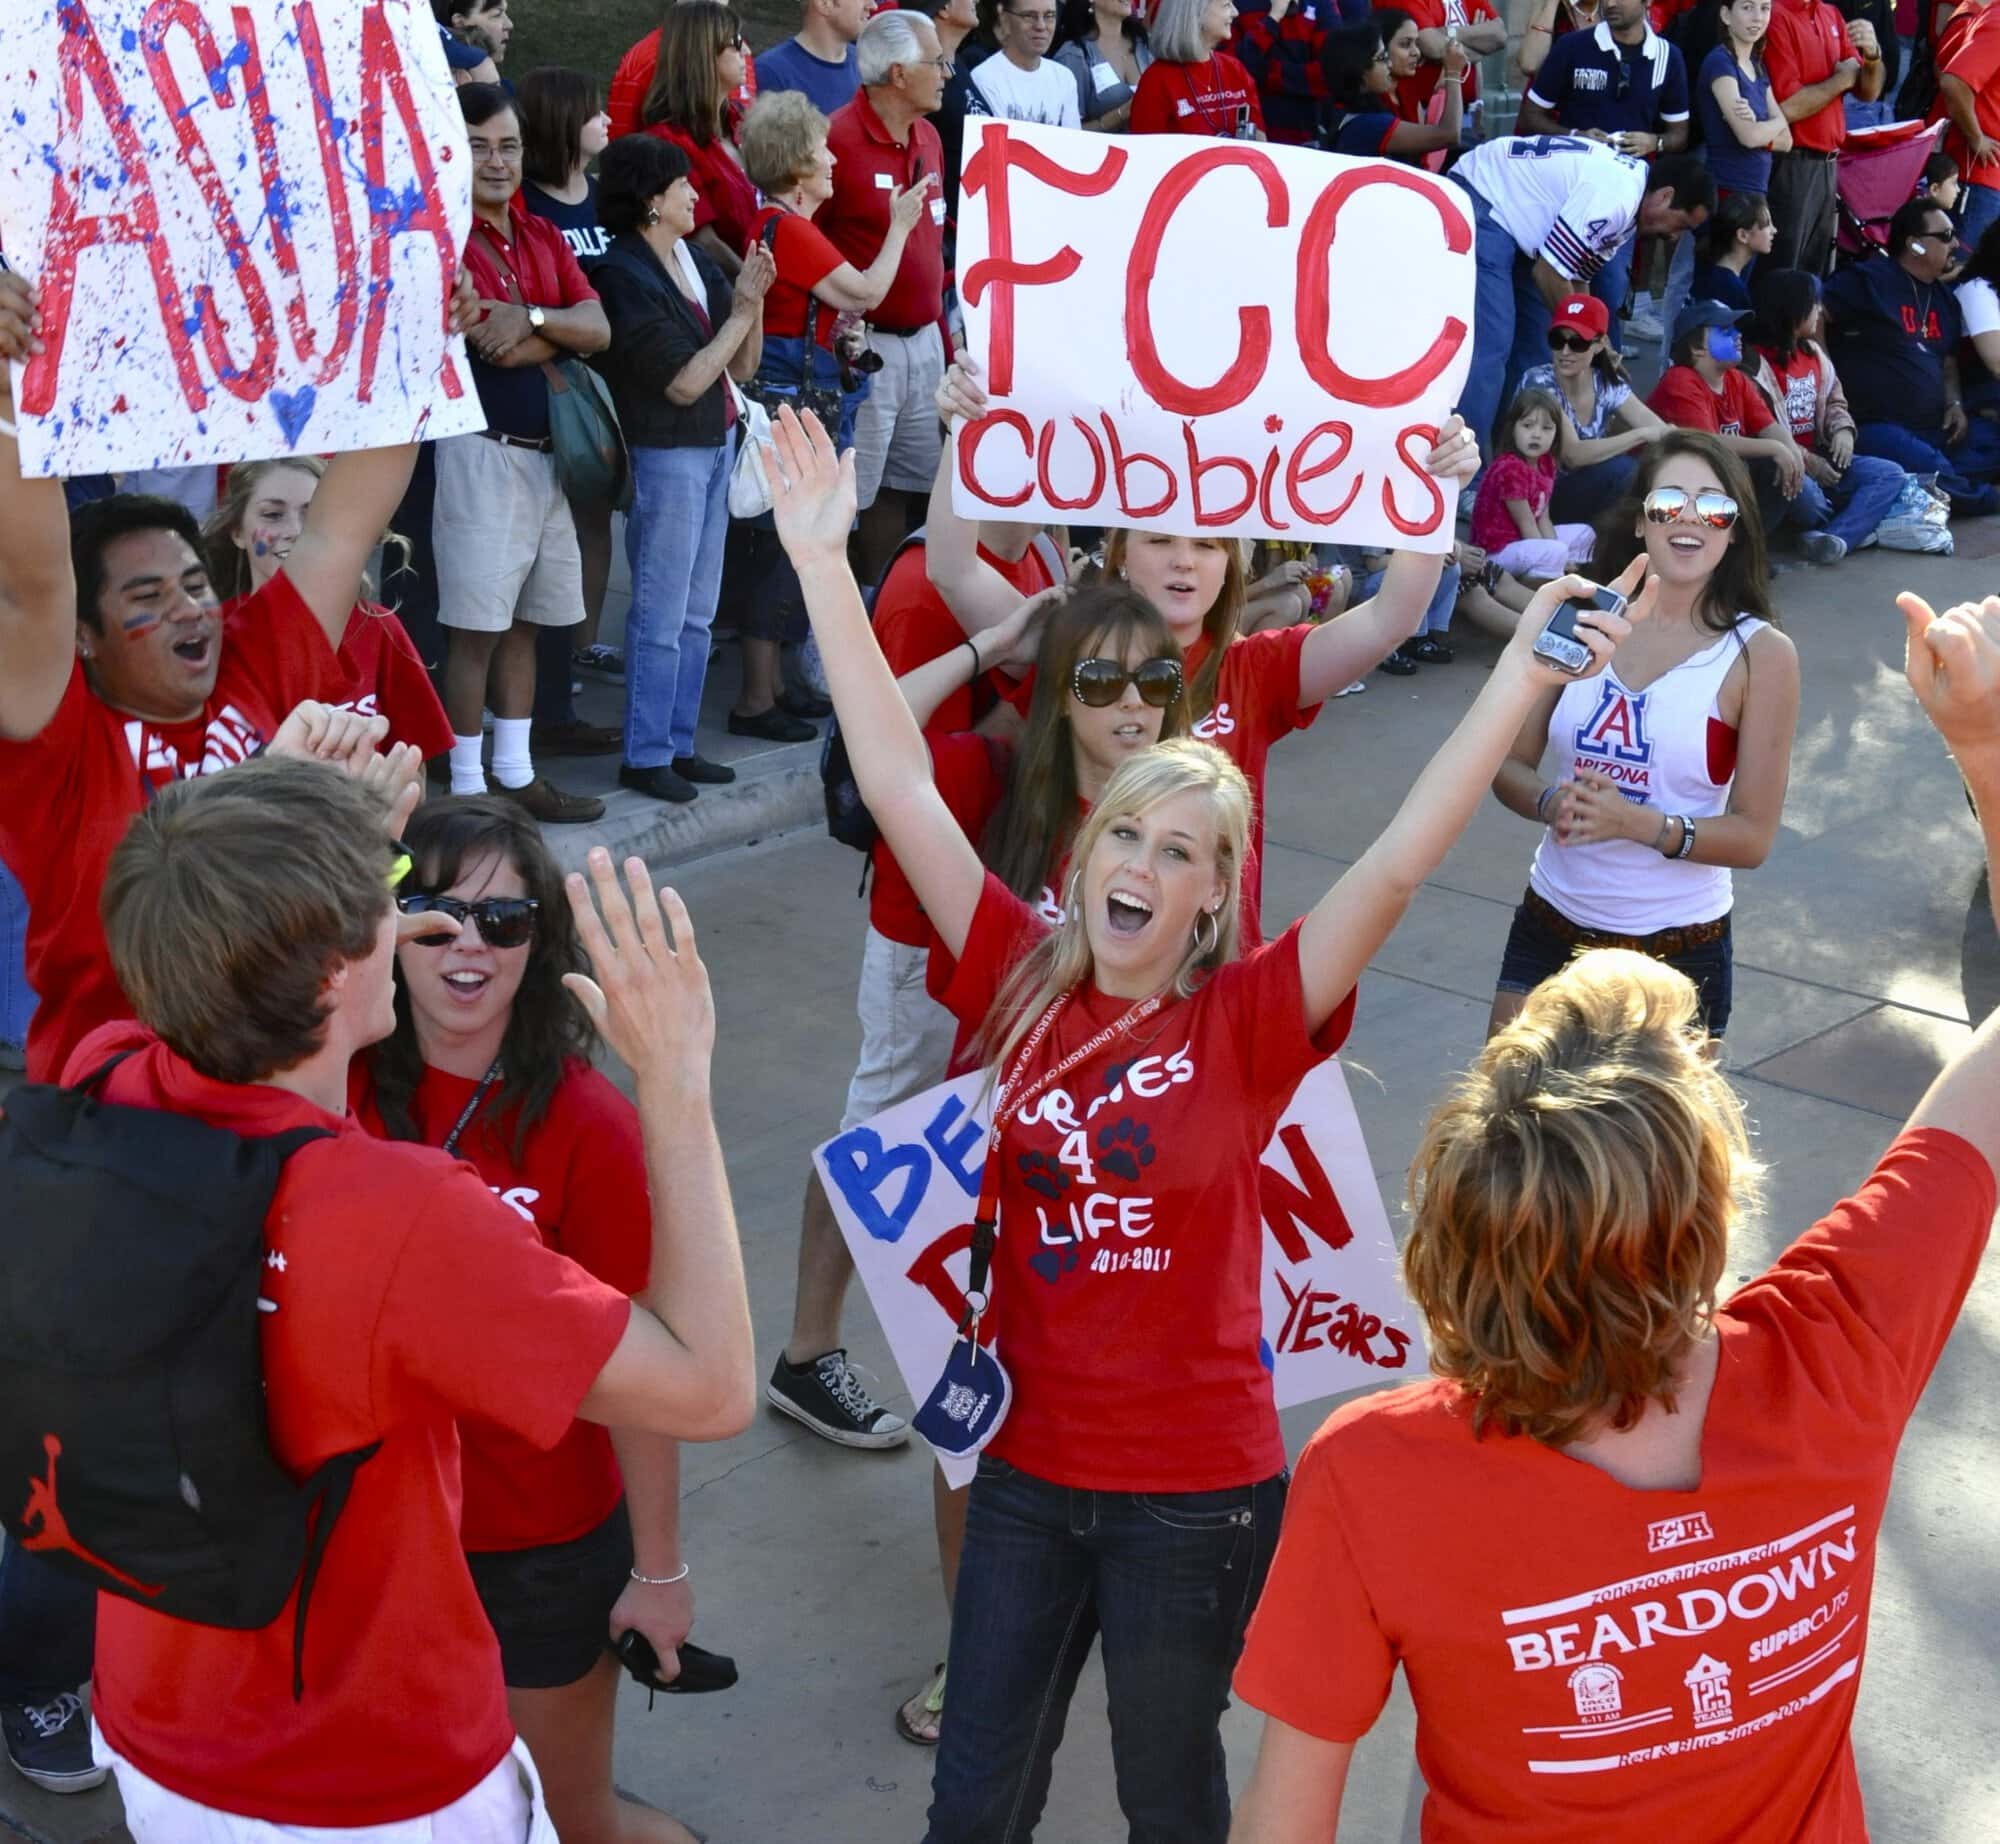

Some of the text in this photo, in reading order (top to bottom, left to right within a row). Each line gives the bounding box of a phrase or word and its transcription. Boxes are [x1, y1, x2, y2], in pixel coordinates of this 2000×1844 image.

[20, 0, 464, 417] ASUA
[960, 123, 1473, 416] FCC
[1058, 1027, 1116, 1072] UNIVERSITY
[1057, 1129, 1097, 1185] 4
[1035, 1191, 1154, 1245] LIFE
[1090, 1246, 1172, 1274] 2010-2011
[1591, 1541, 1783, 1604] zonazoo.arizona.edu
[1748, 1588, 1851, 1663] SUPERCUTS
[1689, 1675, 1732, 1714] 125
[1694, 1706, 1733, 1723] YEARS
